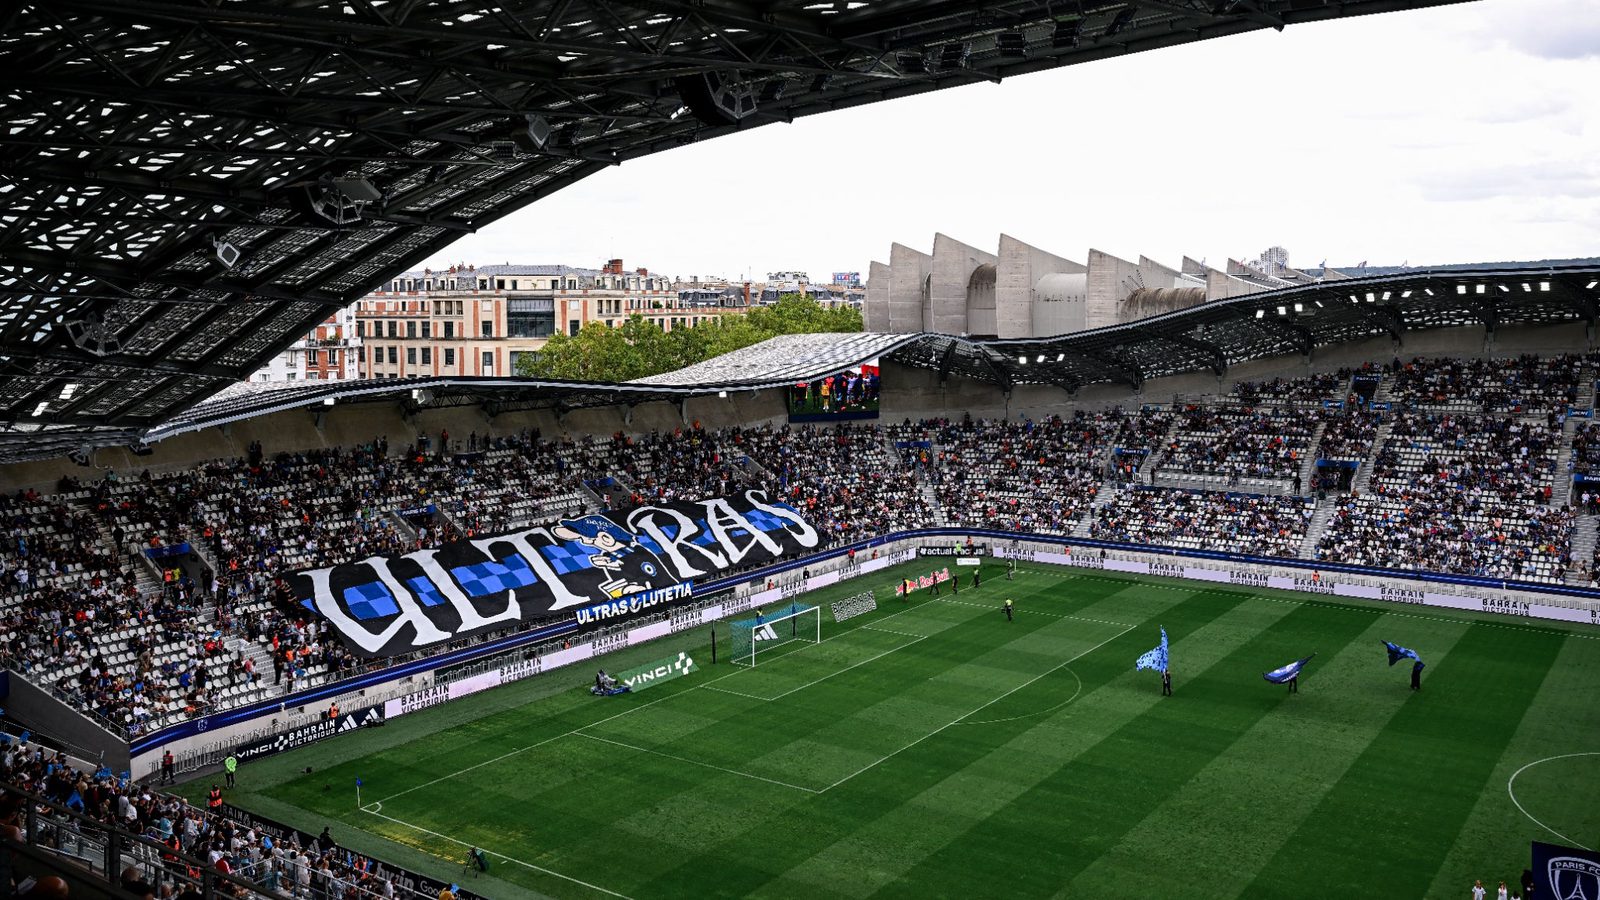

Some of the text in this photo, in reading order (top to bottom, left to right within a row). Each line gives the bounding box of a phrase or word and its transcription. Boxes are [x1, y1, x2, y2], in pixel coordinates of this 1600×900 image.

[927, 547, 952, 555] actual
[1071, 555, 1104, 564] BAHRAIN
[1149, 563, 1185, 573] BAHRAIN
[919, 575, 934, 588] Red
[1229, 571, 1269, 582] BAHRAIN
[1294, 578, 1335, 589] BAHRAIN
[1380, 587, 1425, 599] BAHRAIN
[1380, 595, 1425, 604] VICTORIOUS
[576, 582, 692, 625] ULTRAS LUTETIA
[1482, 599, 1530, 611] BAHRAIN
[670, 610, 703, 626] BAHRAIN
[1482, 606, 1530, 616] VICTORIOUS
[592, 631, 629, 649] BAHRAIN
[500, 657, 542, 676] BAHRAIN
[500, 665, 542, 684] VICTORIOUS
[624, 664, 672, 687] VINCI
[401, 684, 450, 706] BAHRAIN
[401, 694, 450, 714] VICTORIOUS
[288, 719, 335, 741] BAHRAIN
[289, 727, 336, 748] VICTORIOUS
[236, 743, 272, 759] VINCI
[1555, 862, 1585, 870] PARIS
